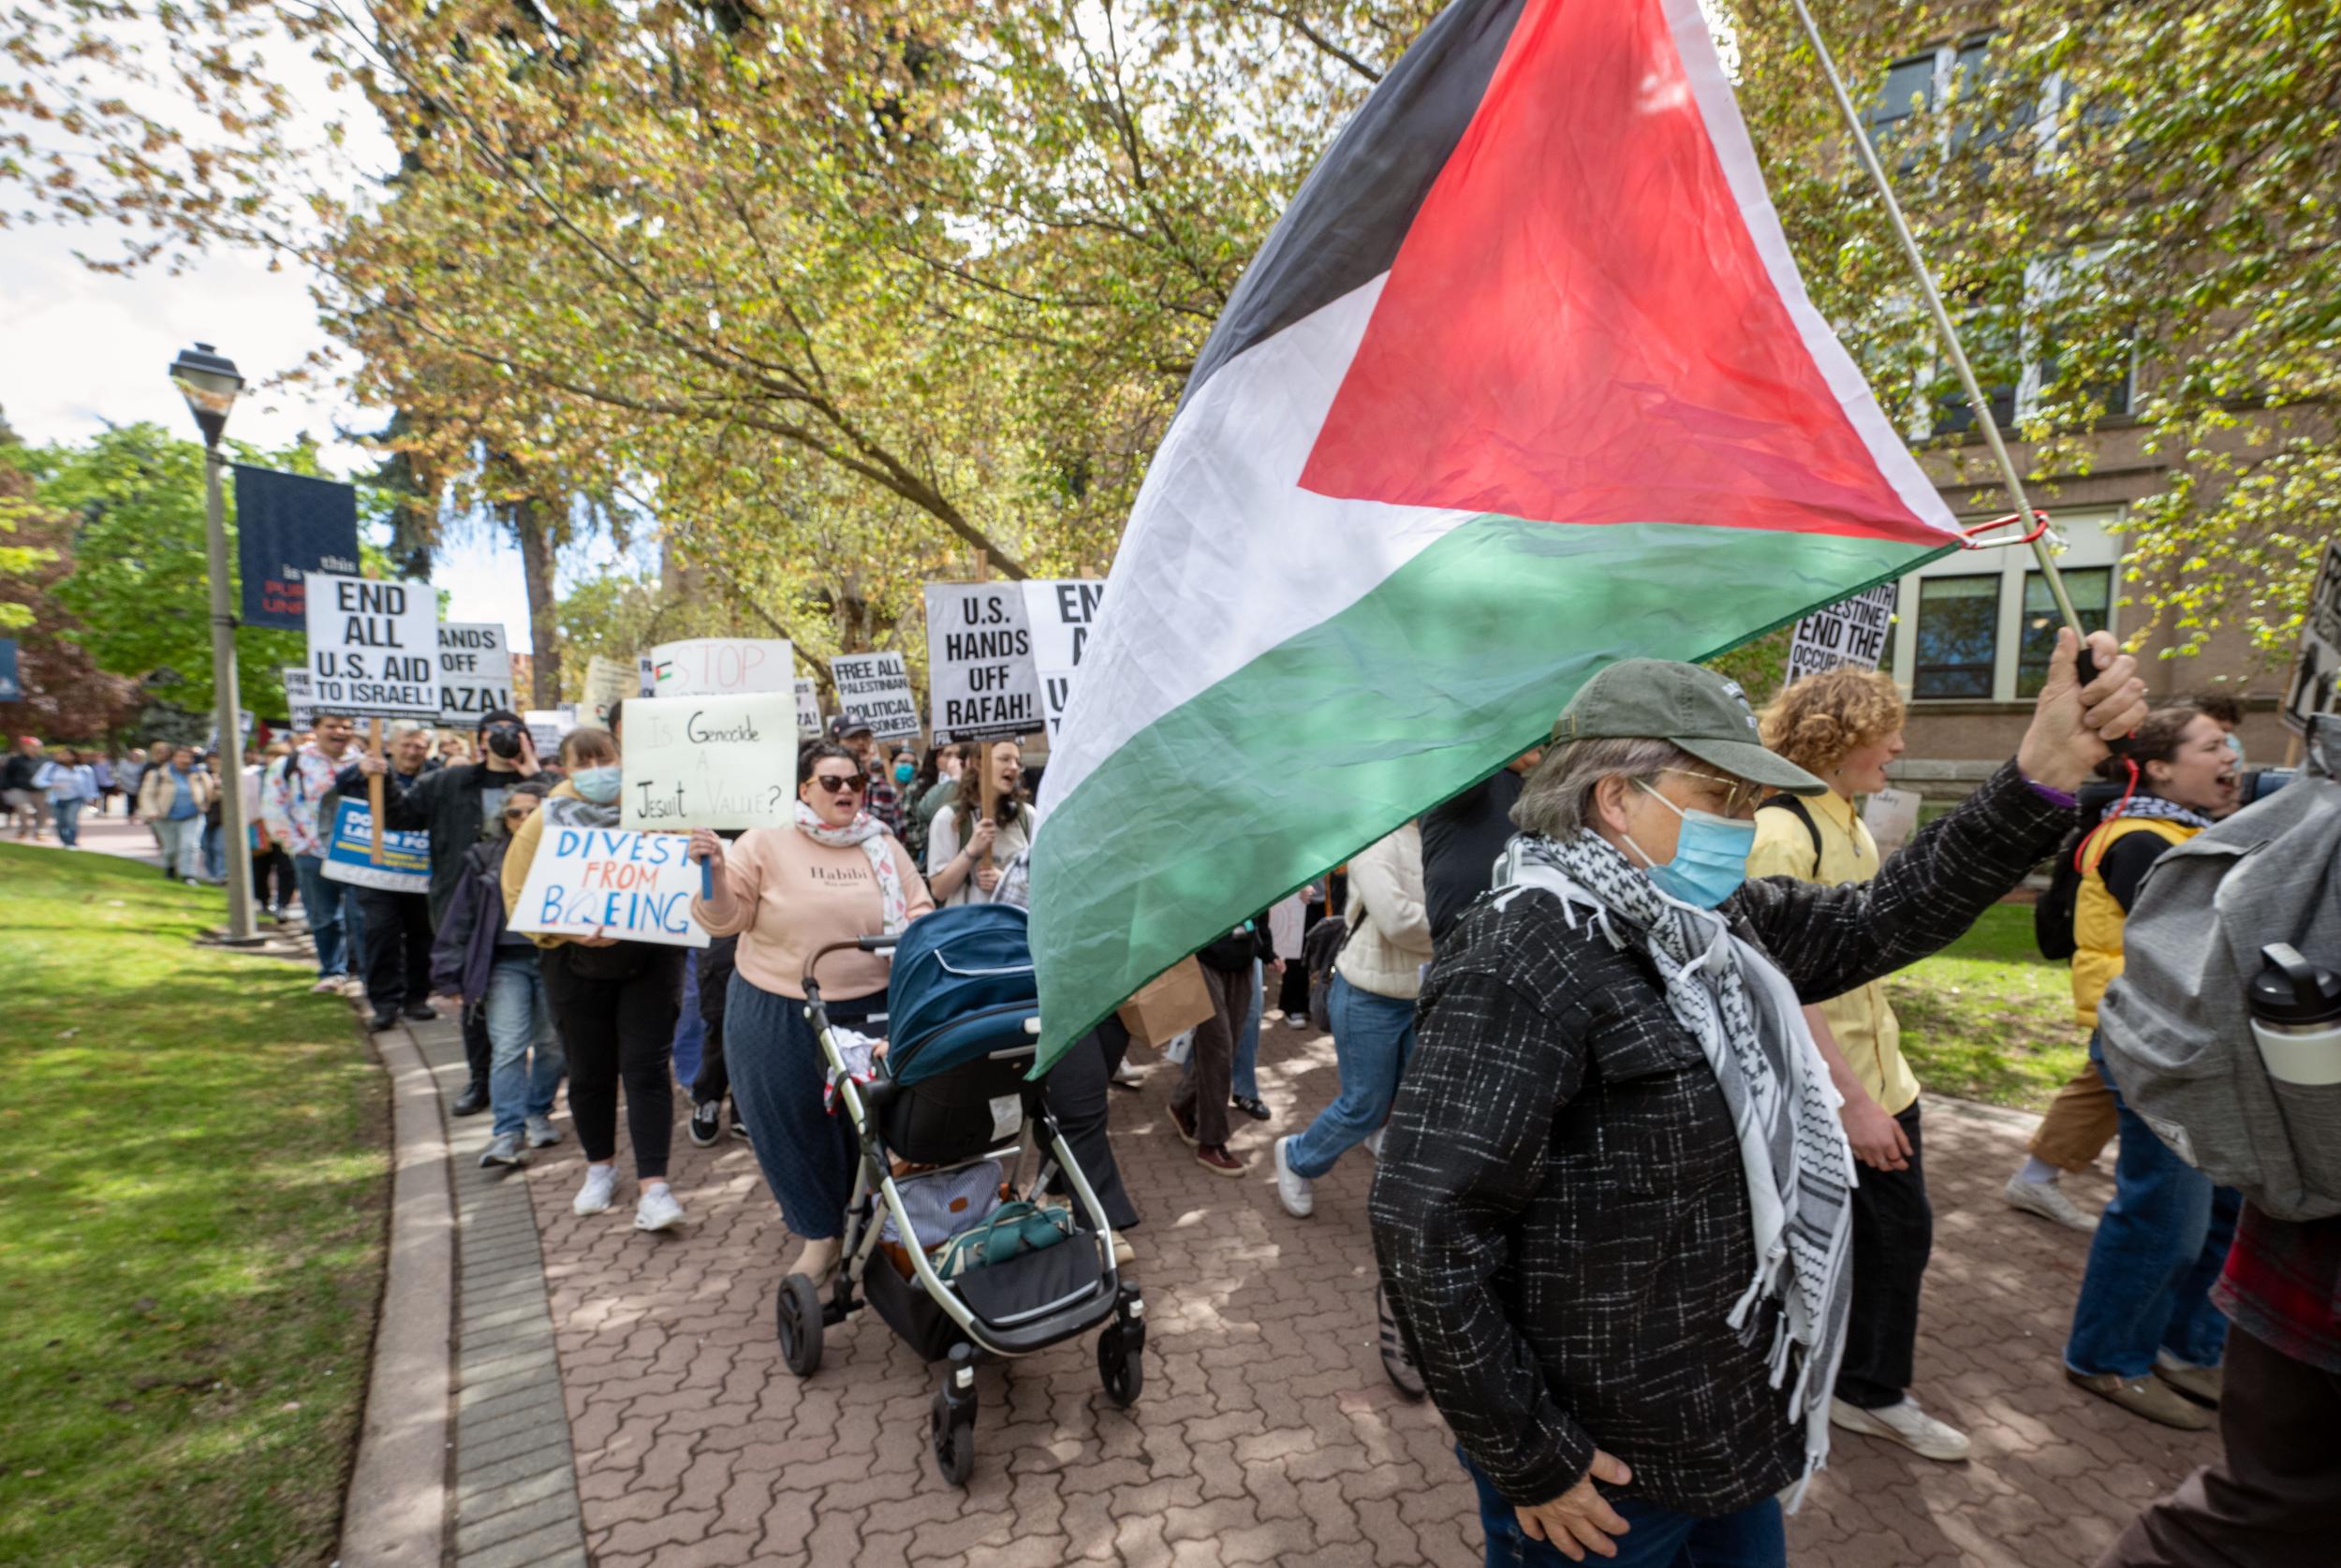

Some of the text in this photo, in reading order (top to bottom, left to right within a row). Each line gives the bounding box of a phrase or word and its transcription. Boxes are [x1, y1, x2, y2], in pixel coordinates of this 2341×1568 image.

[319, 555, 356, 573] this
[337, 581, 406, 615] END
[963, 596, 1011, 625] U.S.
[1056, 583, 1105, 623] EN
[344, 616, 404, 649] ALL
[438, 628, 496, 650] ANDS
[946, 629, 1029, 662] HANDS
[1798, 613, 1884, 661] END THE
[317, 652, 431, 682] U.S. AID
[440, 652, 479, 672] OFF
[674, 644, 766, 690] STOP
[835, 658, 904, 681] FREE ALL
[839, 678, 908, 696] PALESTINIAN
[968, 665, 1010, 692] OFF
[317, 681, 342, 701] TO
[350, 682, 434, 706] ISRAEL!
[441, 687, 508, 712] AZA!
[846, 698, 914, 719] POLITICAL
[947, 693, 1032, 727] RAFAH!
[645, 711, 760, 749] Is Genocide
[870, 716, 917, 733] SONERS
[696, 750, 710, 772] A
[555, 830, 691, 868] DIVEST
[582, 861, 658, 891] FROM
[809, 865, 869, 880] Habibi
